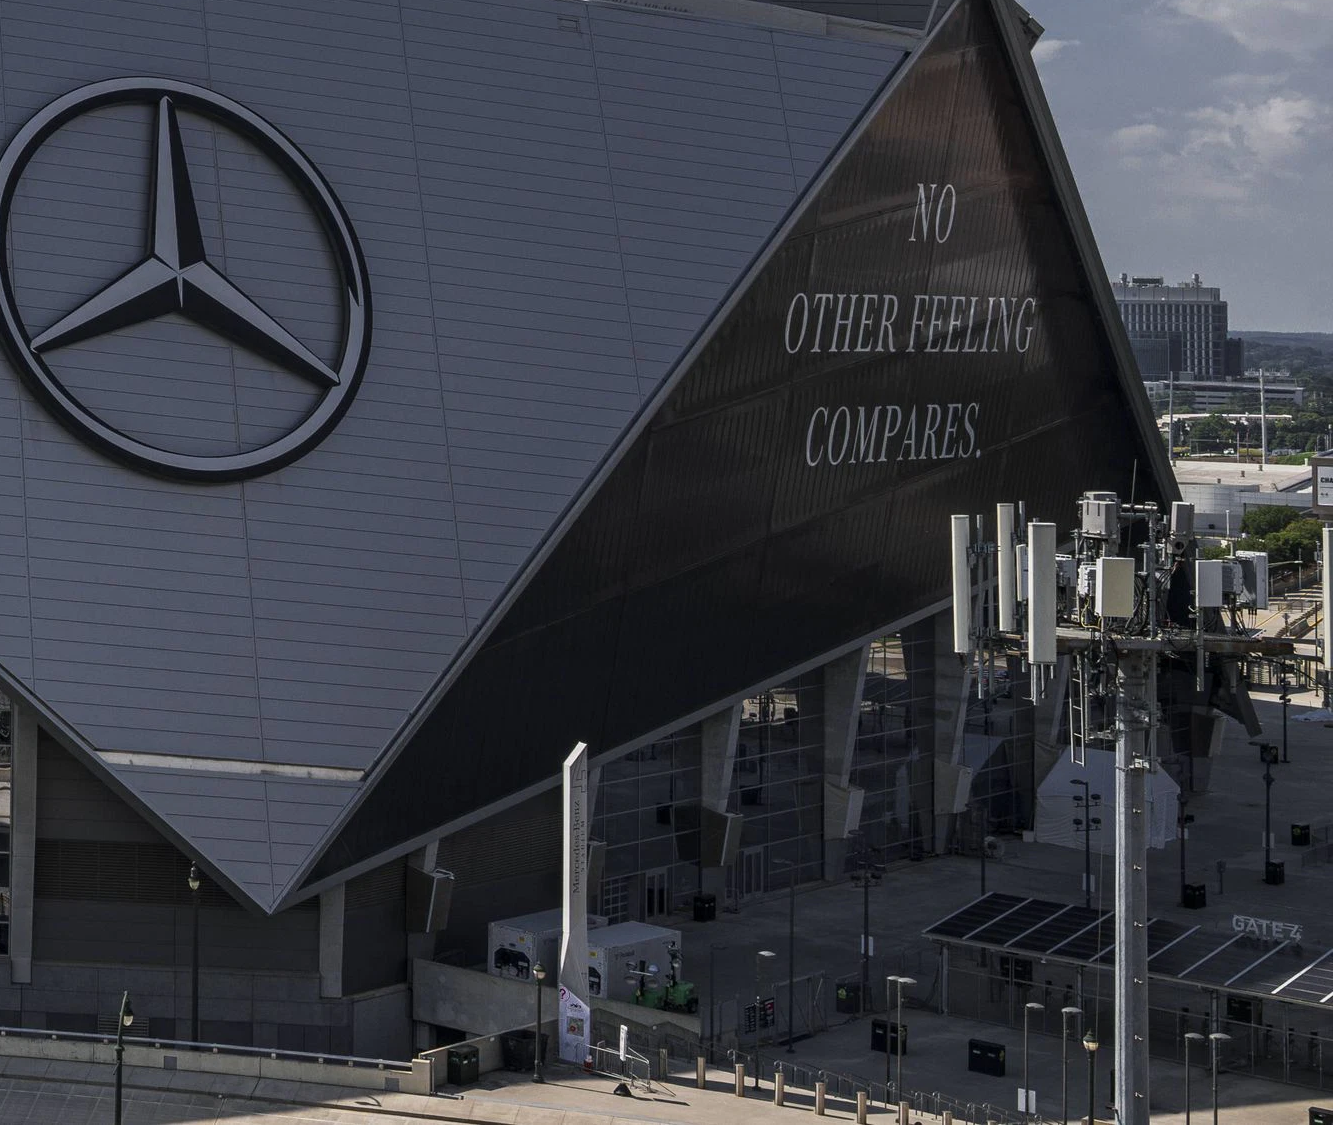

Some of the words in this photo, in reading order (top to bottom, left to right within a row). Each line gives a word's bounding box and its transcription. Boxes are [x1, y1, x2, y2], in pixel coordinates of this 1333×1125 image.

[908, 183, 957, 243] NO
[784, 293, 900, 354] OTHER
[905, 294, 1036, 353] FEELING
[805, 402, 981, 466] COMPARES.
[572, 800, 581, 894] Mercedes-Benz
[1232, 915, 1283, 938] GATE
[1290, 924, 1301, 941] 4
